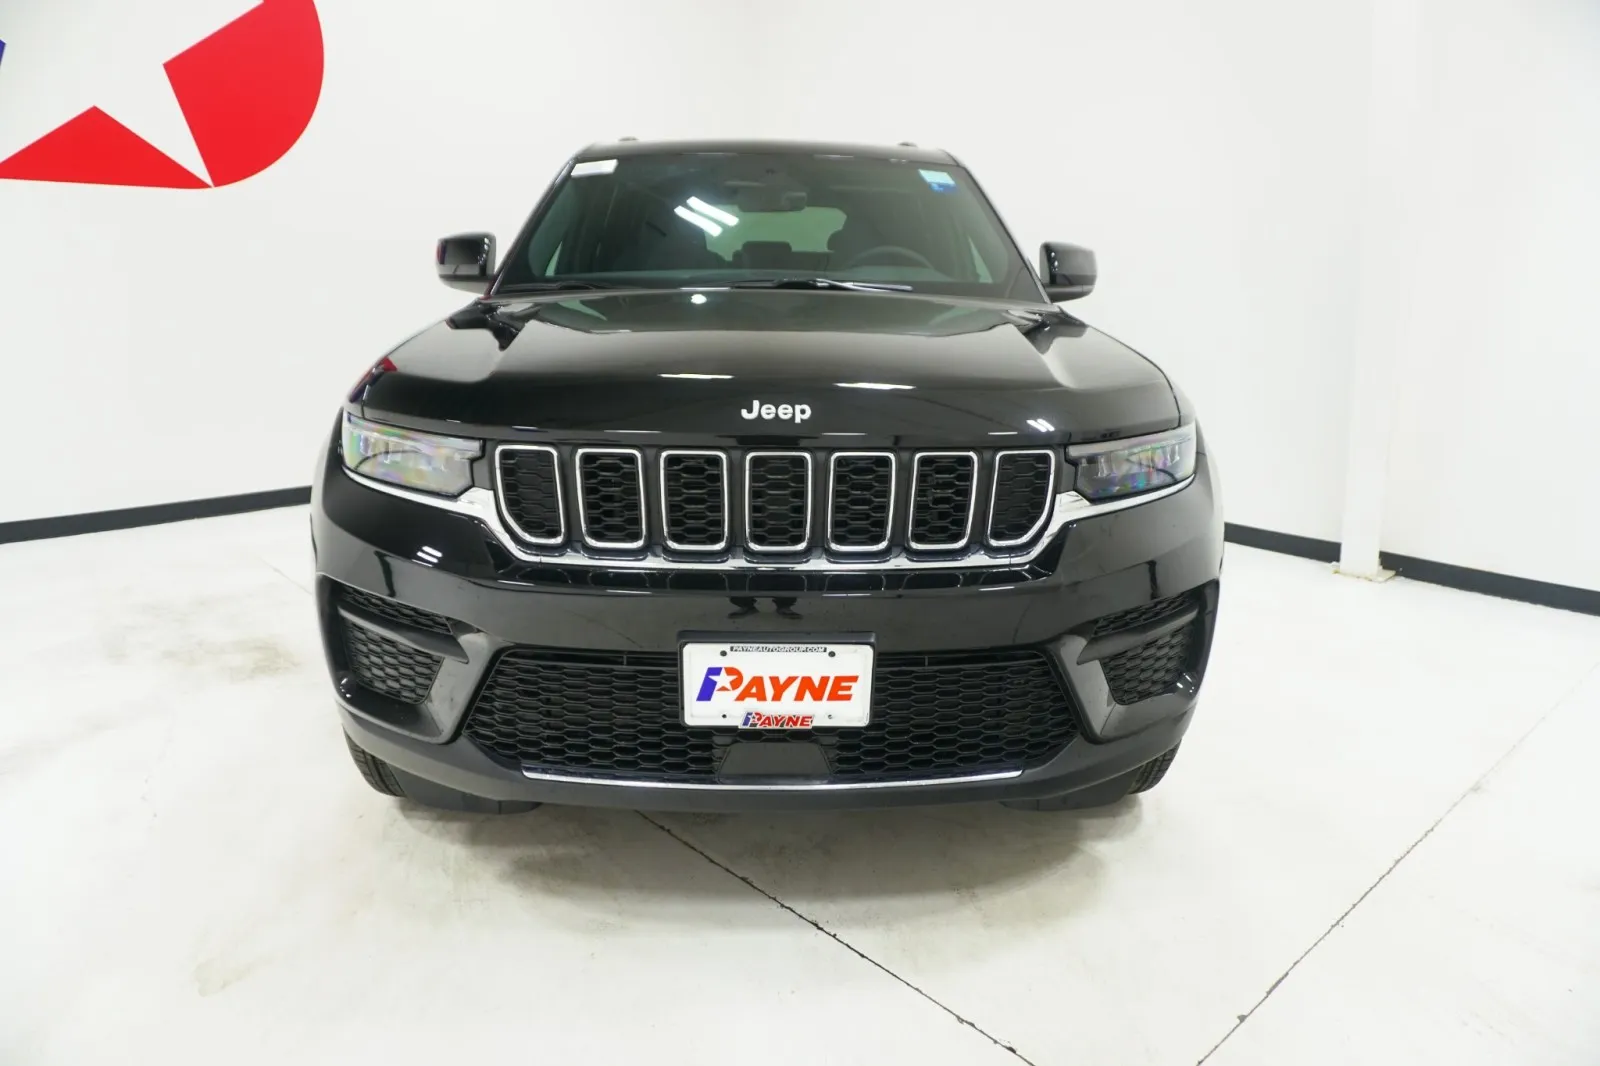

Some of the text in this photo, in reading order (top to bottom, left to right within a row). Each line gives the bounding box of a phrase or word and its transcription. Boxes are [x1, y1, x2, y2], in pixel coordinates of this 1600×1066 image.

[741, 399, 812, 424] Jeep
[733, 645, 824, 653] PAYNEAUTOGROUP.COM
[696, 666, 859, 702] PAYNE
[742, 712, 813, 727] PAYNE
